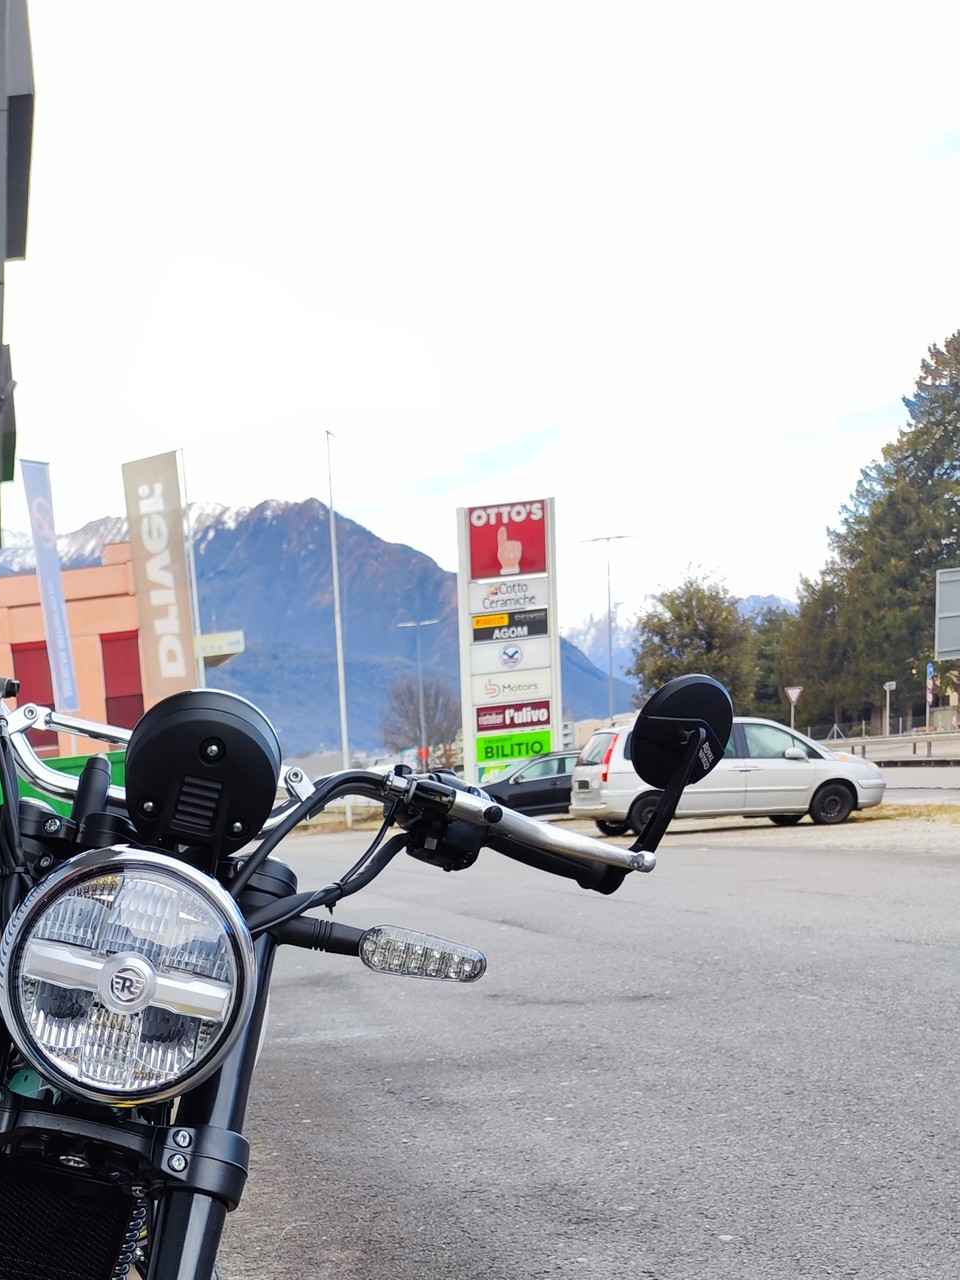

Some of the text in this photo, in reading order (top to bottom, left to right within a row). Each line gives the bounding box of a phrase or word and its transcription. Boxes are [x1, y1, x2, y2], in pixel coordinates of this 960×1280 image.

[470, 502, 544, 527] OTTO'S
[498, 583, 528, 595] Cotto
[482, 594, 536, 609] Ceramiche
[492, 625, 529, 640] AGOM
[502, 683, 538, 693] Motors
[484, 741, 544, 759] BILITIO
[702, 741, 715, 763] ROYAL
